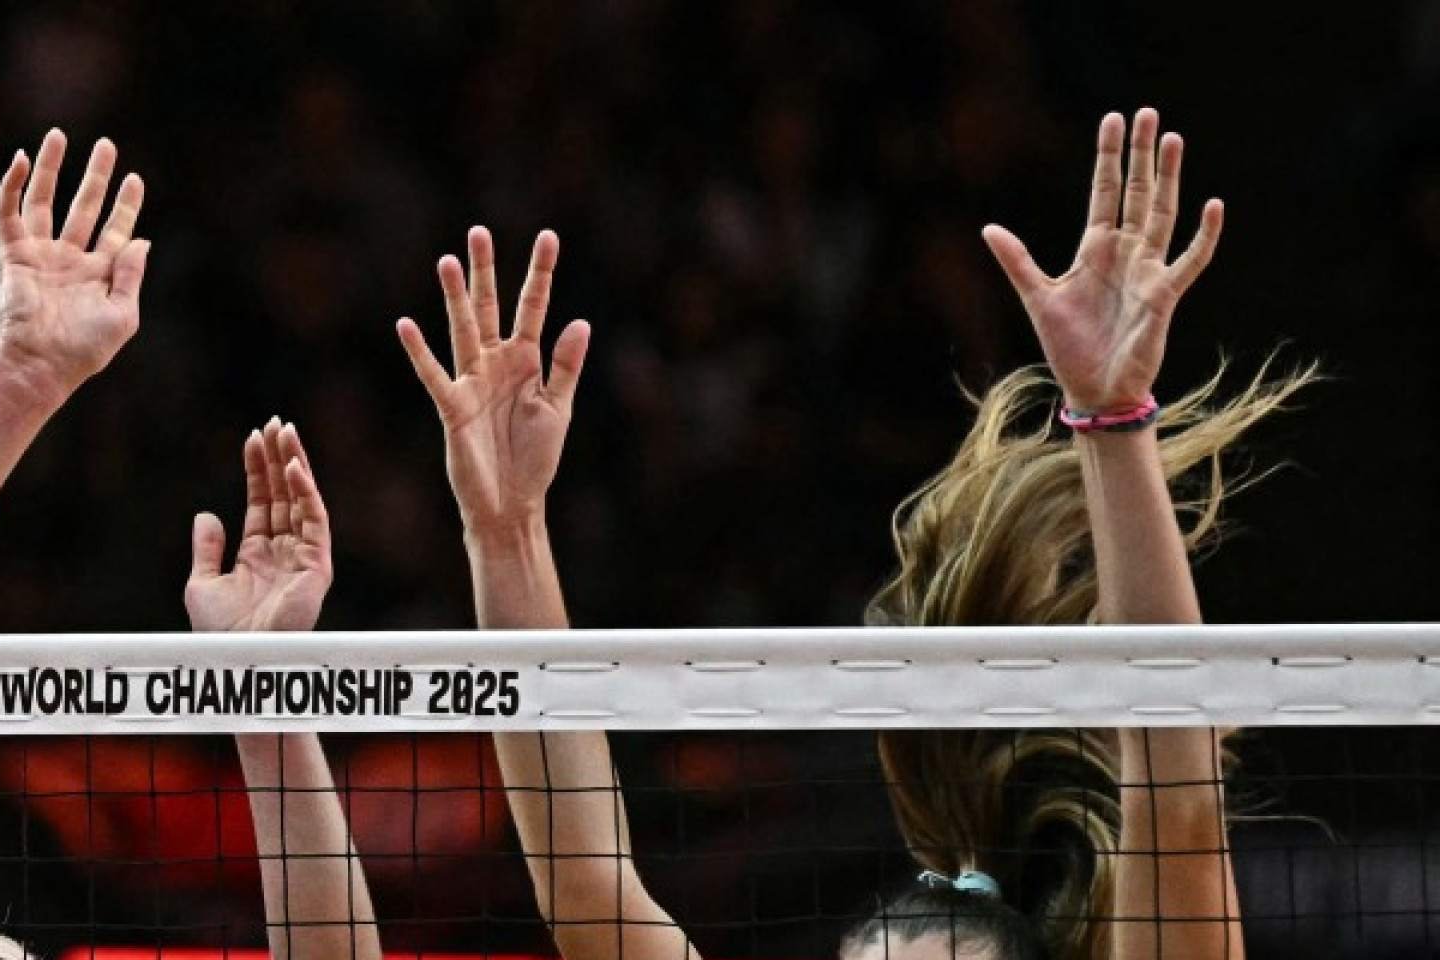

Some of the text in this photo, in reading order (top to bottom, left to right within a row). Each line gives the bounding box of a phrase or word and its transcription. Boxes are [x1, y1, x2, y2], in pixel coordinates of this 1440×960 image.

[0, 668, 129, 716] WORLD
[145, 668, 414, 716] CHAMPIONSHIP
[427, 670, 520, 716] 2025
